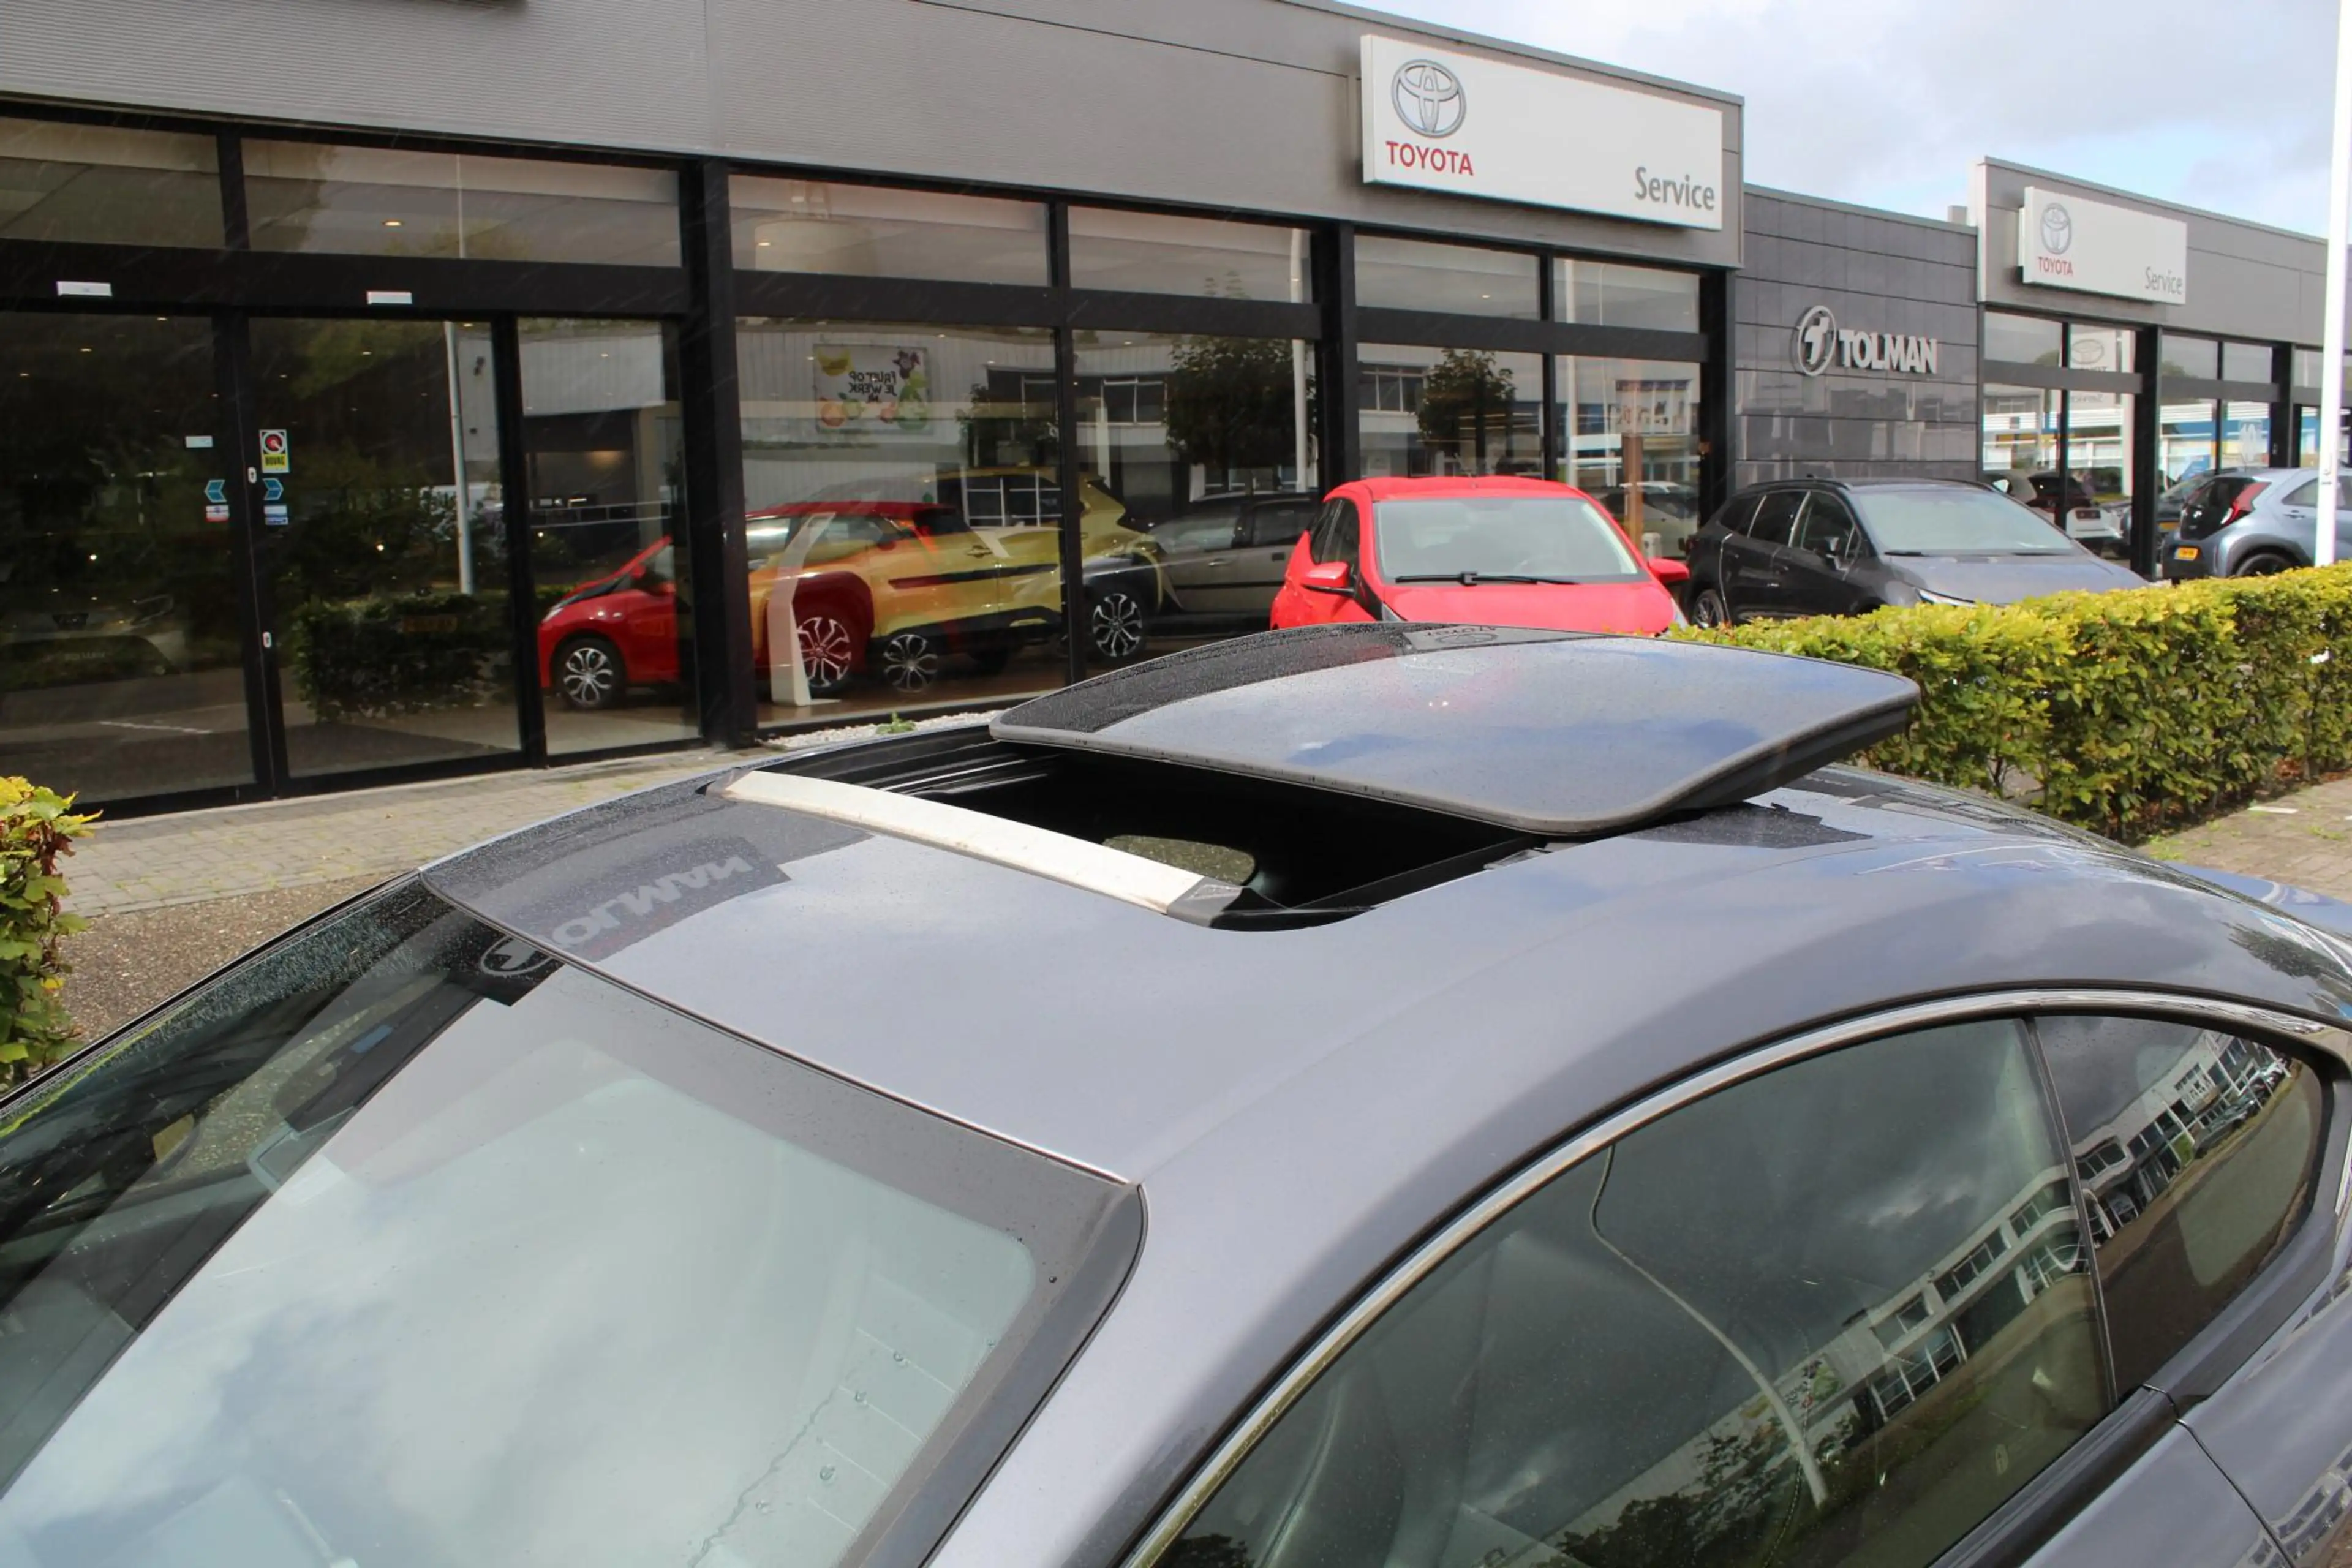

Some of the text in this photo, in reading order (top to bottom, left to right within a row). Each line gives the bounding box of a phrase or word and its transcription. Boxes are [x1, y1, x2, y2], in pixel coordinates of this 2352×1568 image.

[1385, 140, 1474, 176] TOYOTA
[1635, 166, 1714, 211] Service
[2038, 256, 2073, 276] TOYOTA
[2145, 266, 2184, 295] Service
[1839, 328, 1938, 374] TOLMAN
